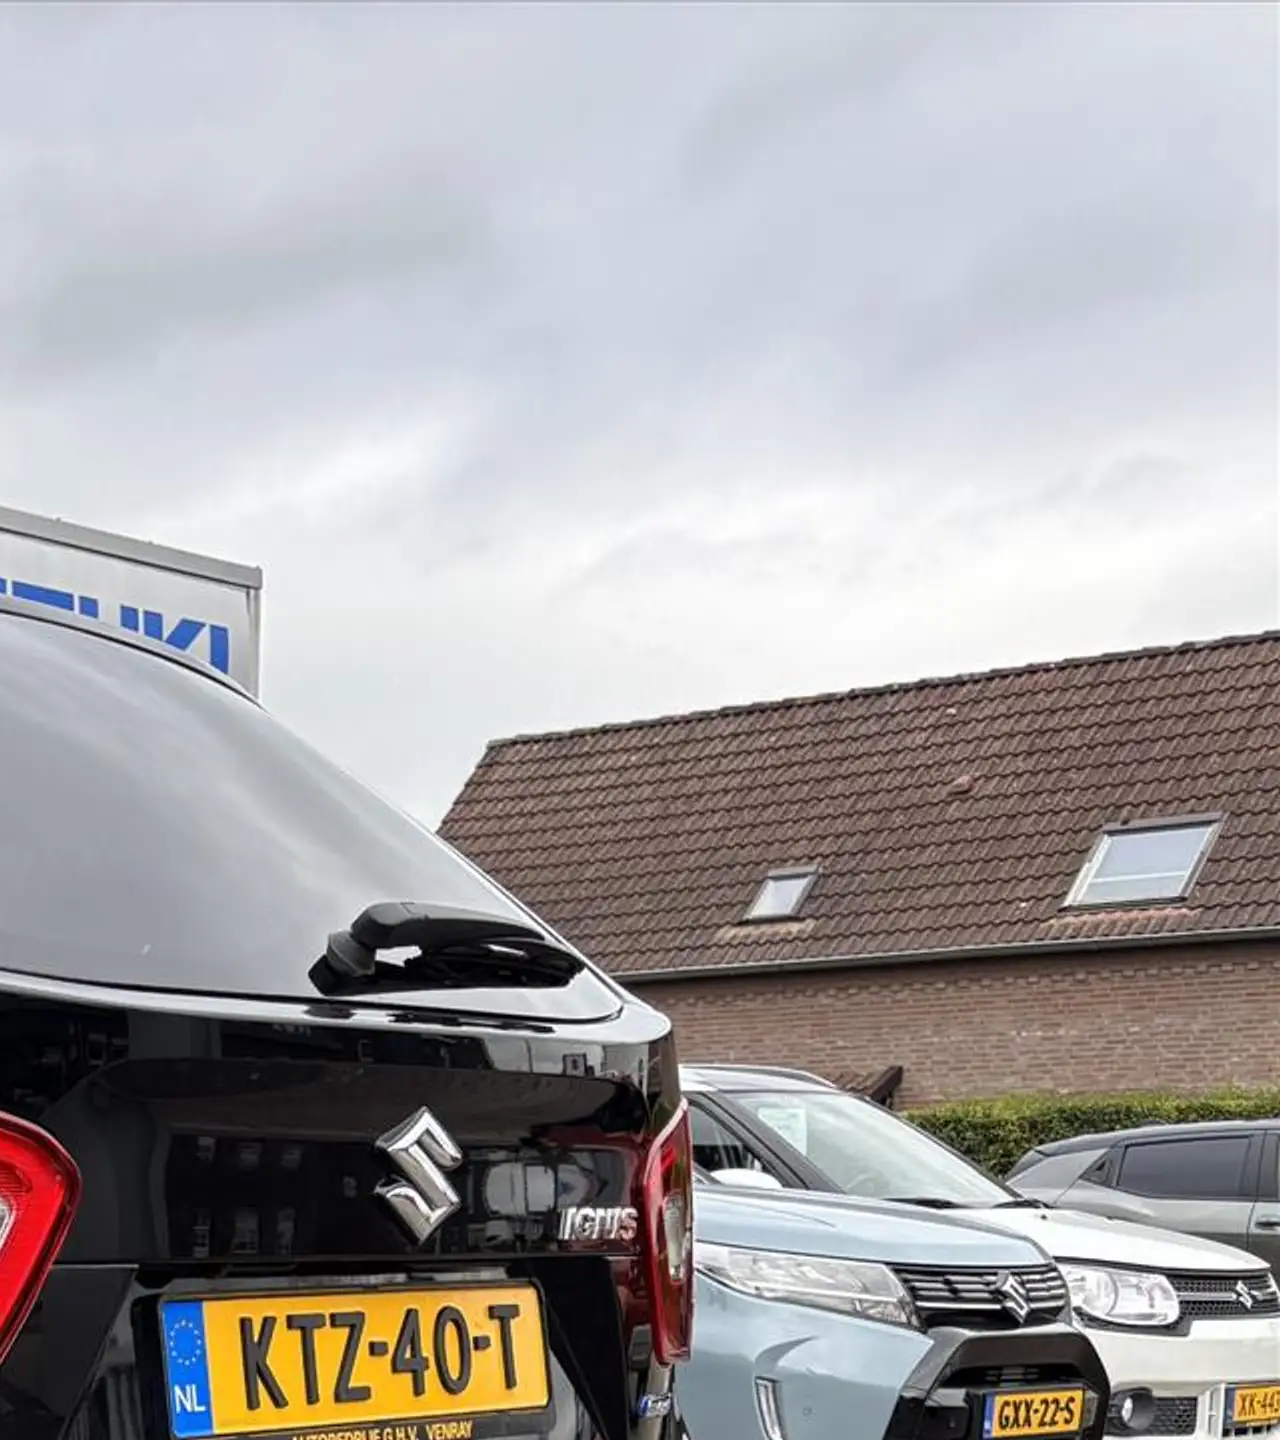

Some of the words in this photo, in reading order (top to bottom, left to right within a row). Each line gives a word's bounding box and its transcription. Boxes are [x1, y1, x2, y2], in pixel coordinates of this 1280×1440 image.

[238, 1303, 521, 1411] KTZ-40-T
[173, 1383, 207, 1414] NL
[998, 1396, 1076, 1430] GXX-22-S
